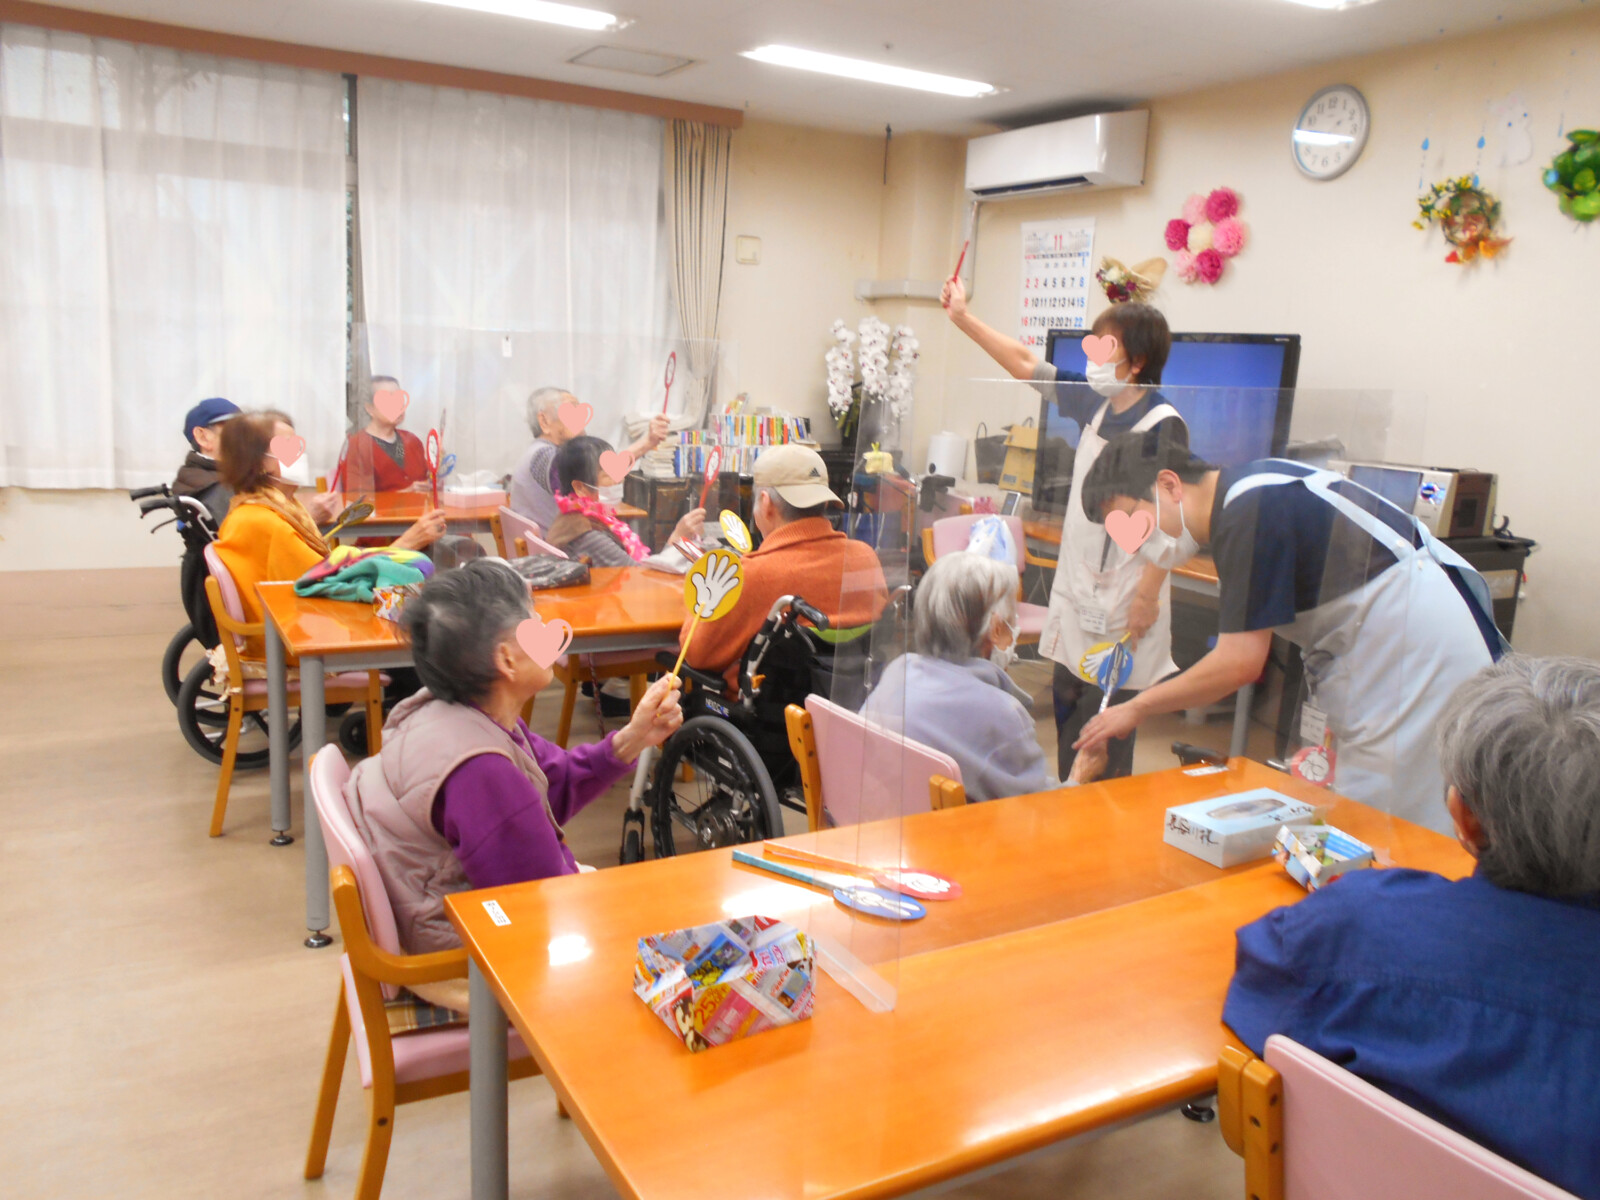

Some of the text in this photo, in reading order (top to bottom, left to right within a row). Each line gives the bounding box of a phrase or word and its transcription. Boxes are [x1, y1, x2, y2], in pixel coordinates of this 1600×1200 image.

[1054, 235, 1063, 251] 11
[1025, 277, 1030, 288] 2
[1043, 277, 1048, 288] 4
[1052, 277, 1057, 288] 5
[1061, 277, 1066, 288] 6
[1070, 277, 1075, 288] 7
[1031, 297, 1039, 307] 10
[1040, 297, 1047, 307] 11
[1049, 297, 1056, 307] 12
[1058, 297, 1066, 307] 13
[1067, 297, 1075, 307] 14
[1076, 297, 1085, 307] 15
[1021, 316, 1083, 327] 16 17 18 19 20 21 22
[1027, 336, 1035, 346] 24
[1036, 336, 1044, 346] 25
